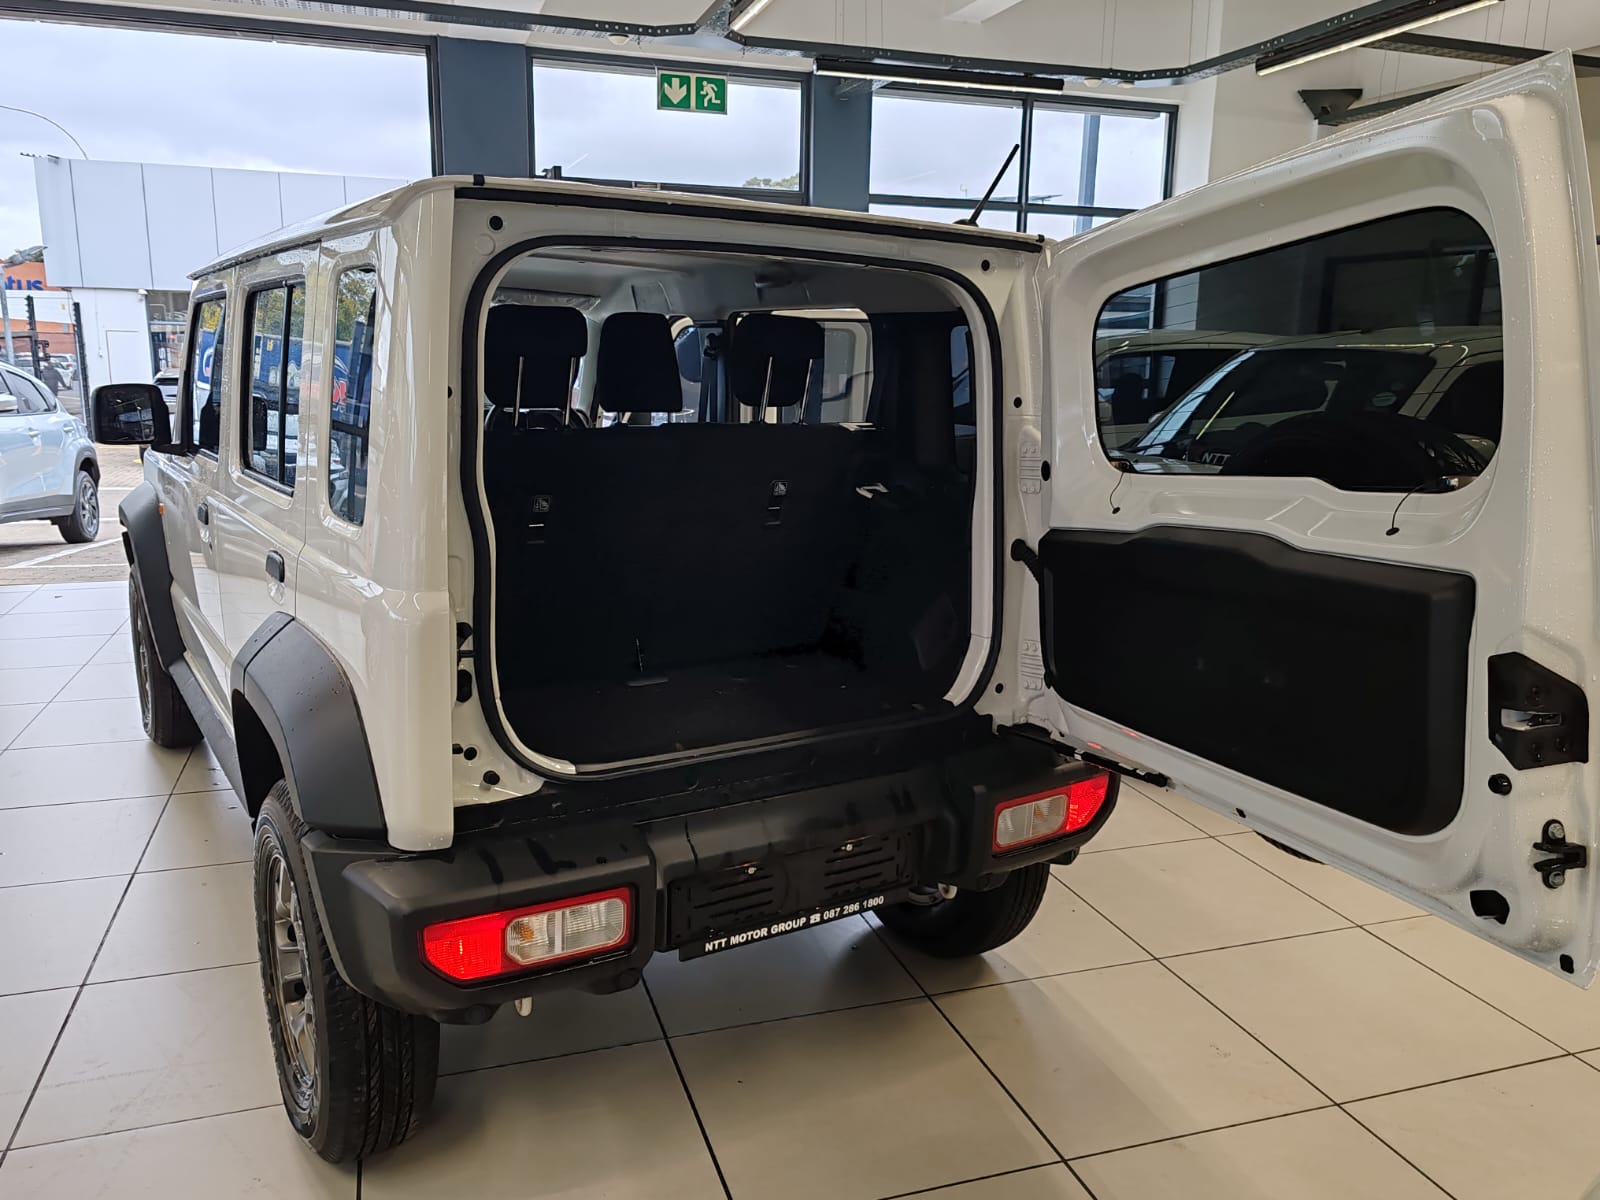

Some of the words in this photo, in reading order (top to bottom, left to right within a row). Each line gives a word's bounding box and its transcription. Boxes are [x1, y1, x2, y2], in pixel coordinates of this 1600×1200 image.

[1202, 452, 1231, 465] NTT
[705, 937, 728, 952] NTT
[730, 926, 768, 946] MOTOR
[770, 917, 807, 935] GROUP
[823, 907, 841, 920] 087
[842, 902, 860, 914] 286
[862, 895, 884, 909] 1800
